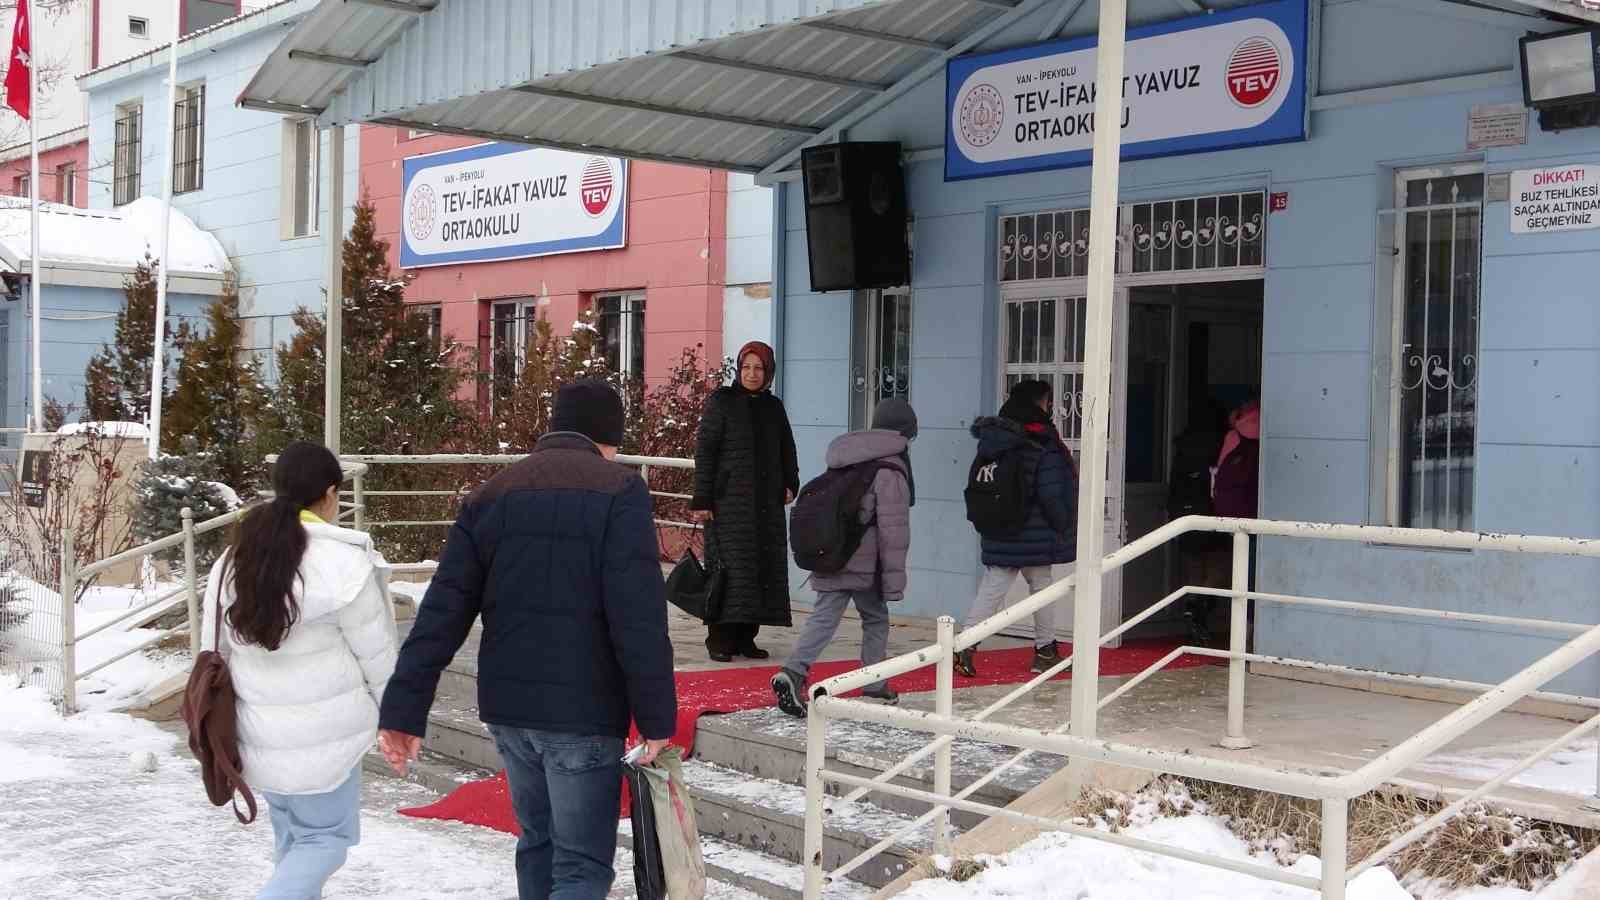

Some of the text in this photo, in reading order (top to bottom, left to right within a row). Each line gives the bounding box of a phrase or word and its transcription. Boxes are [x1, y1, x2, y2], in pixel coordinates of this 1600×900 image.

[1016, 74, 1032, 84] VAN
[1039, 66, 1077, 81] İPEKYOLU
[1135, 64, 1201, 96] YAVUZ
[1231, 72, 1276, 94] TEV
[1014, 106, 1130, 143] ORTAOKU
[1533, 170, 1585, 185] DİKKAT!
[442, 175, 568, 214] TEV-İFAKAT YAVUZ
[583, 187, 609, 204] TEV
[1521, 183, 1599, 202] BUZ TEHLİKESİ
[1513, 202, 1550, 217] SAÇAK
[442, 212, 520, 242] ORTAOKULU
[1527, 213, 1592, 230] GEÇMEYİNİZ
